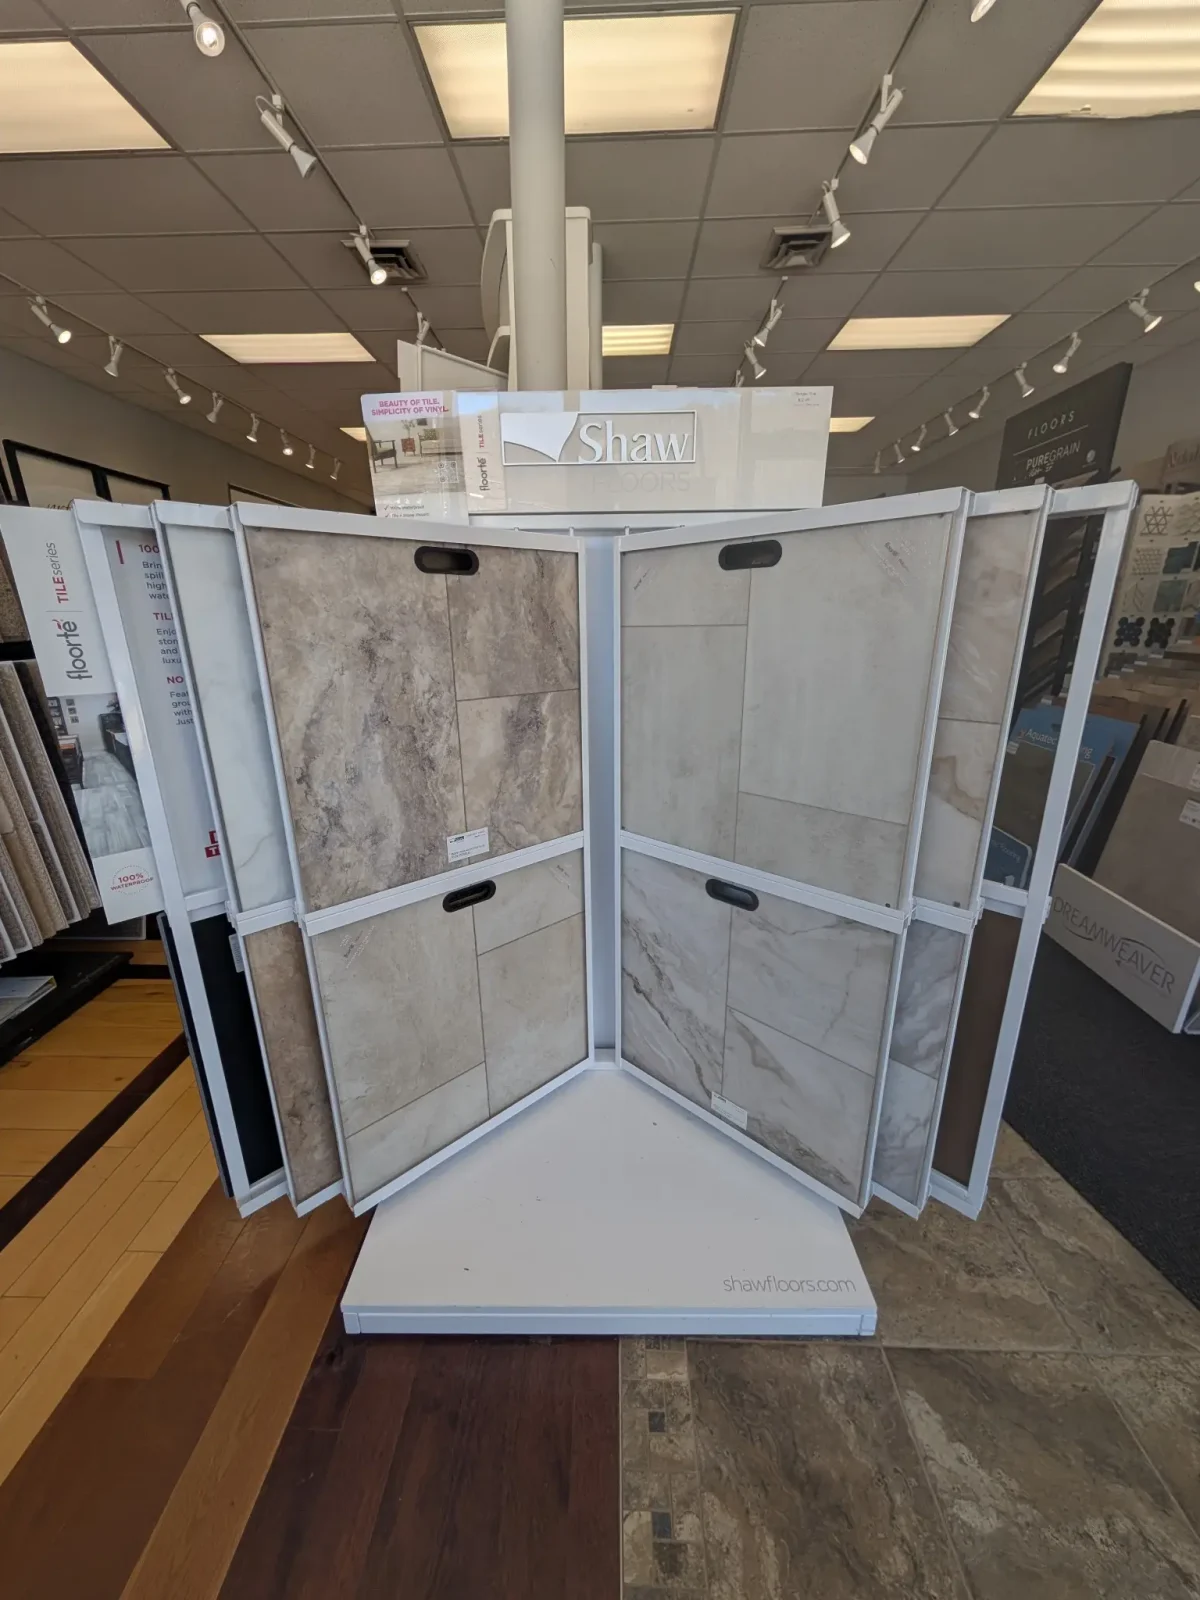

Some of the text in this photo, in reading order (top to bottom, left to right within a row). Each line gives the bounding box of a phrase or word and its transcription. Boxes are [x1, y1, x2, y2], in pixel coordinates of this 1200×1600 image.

[379, 399, 408, 408] BEAUTY
[371, 406, 410, 416] SIMPLICITY
[411, 406, 422, 414] OF
[1027, 410, 1075, 439] FLOORS
[578, 419, 690, 463] Shaw
[1026, 441, 1081, 471] PUREGRAIN
[592, 471, 691, 494] FLOORS
[153, 612, 173, 621] TIL
[161, 647, 178, 655] and
[167, 675, 184, 684] NO
[174, 708, 192, 716] with
[110, 876, 154, 891] WATERPROOF
[118, 872, 144, 884] 100%
[1053, 896, 1176, 994] DREAMWEAVER
[722, 1275, 857, 1293] shawfloors.com
